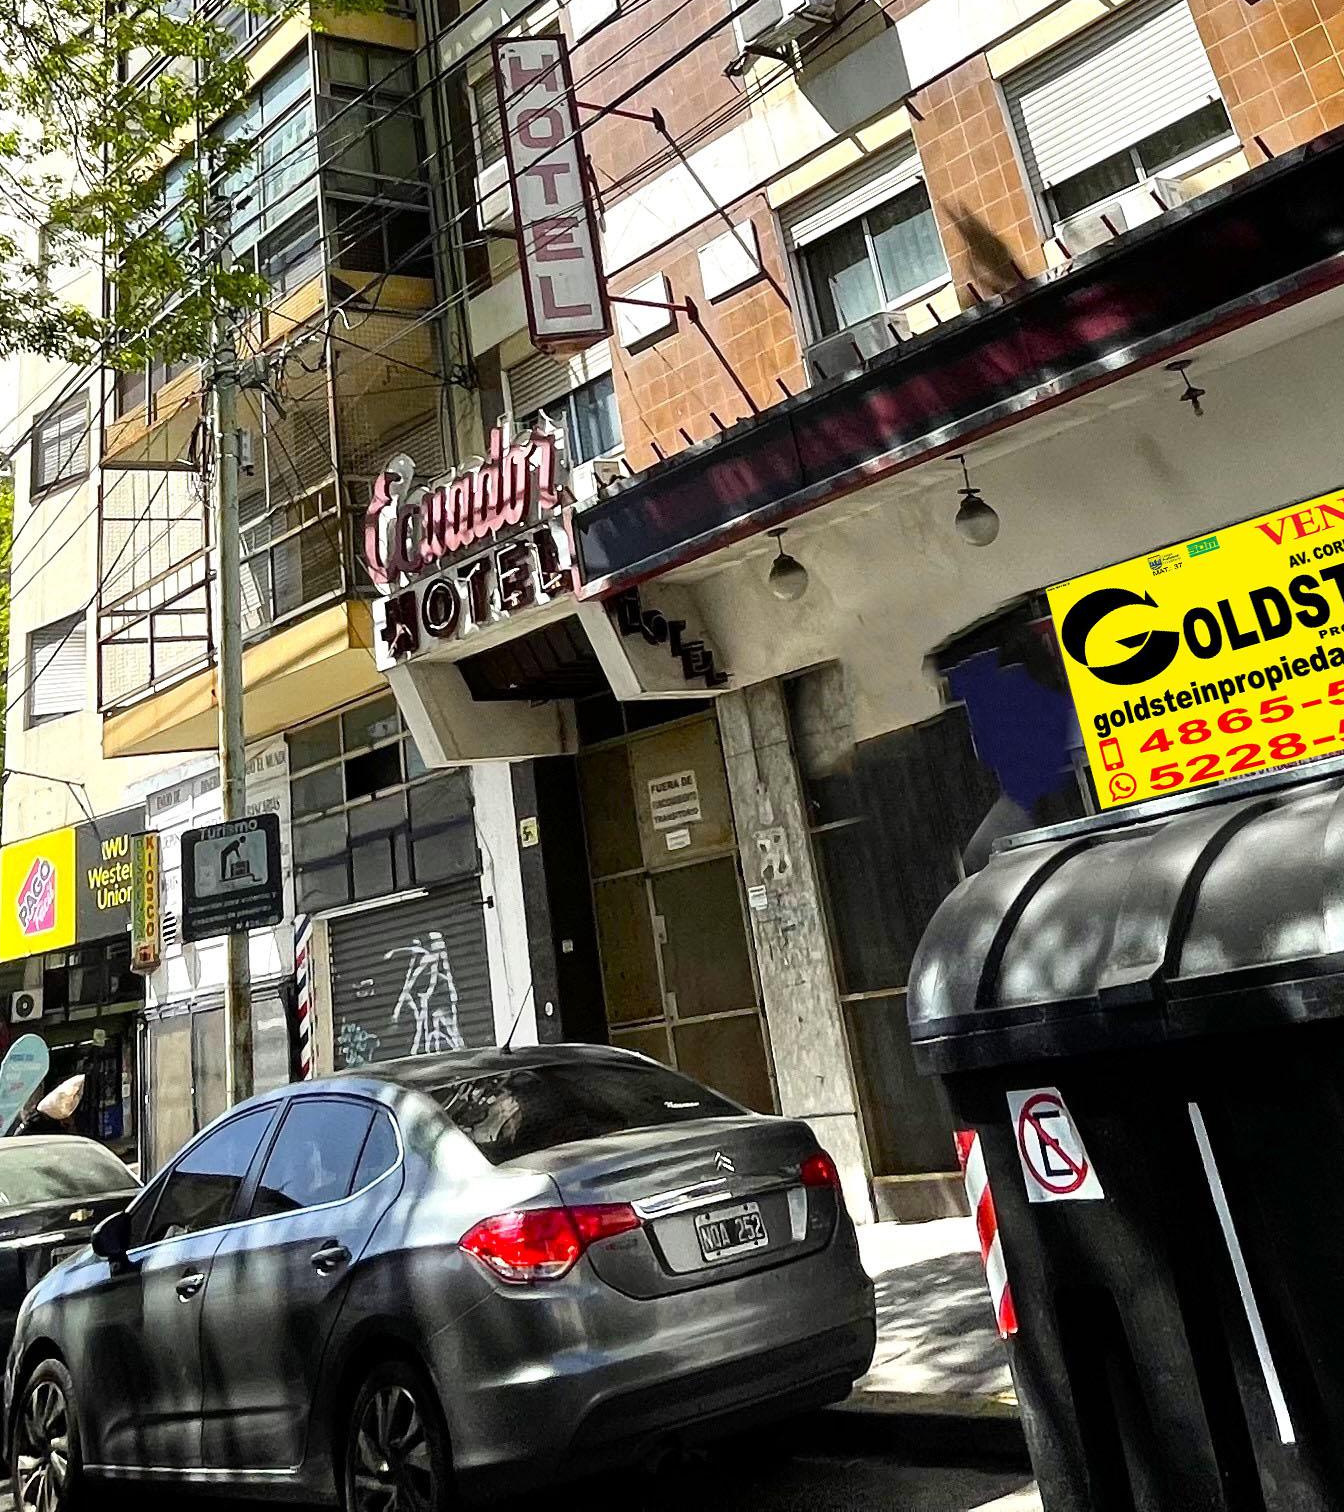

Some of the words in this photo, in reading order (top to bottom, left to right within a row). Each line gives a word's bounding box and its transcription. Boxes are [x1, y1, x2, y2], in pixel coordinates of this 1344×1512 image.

[507, 53, 594, 320] HOTEL
[380, 524, 574, 659] HOTEL
[1289, 550, 1311, 569] AV.
[200, 819, 258, 841] Turismo
[19, 860, 51, 927] PAGO
[145, 835, 156, 938] KIOSCO
[735, 1214, 763, 1242] 252
